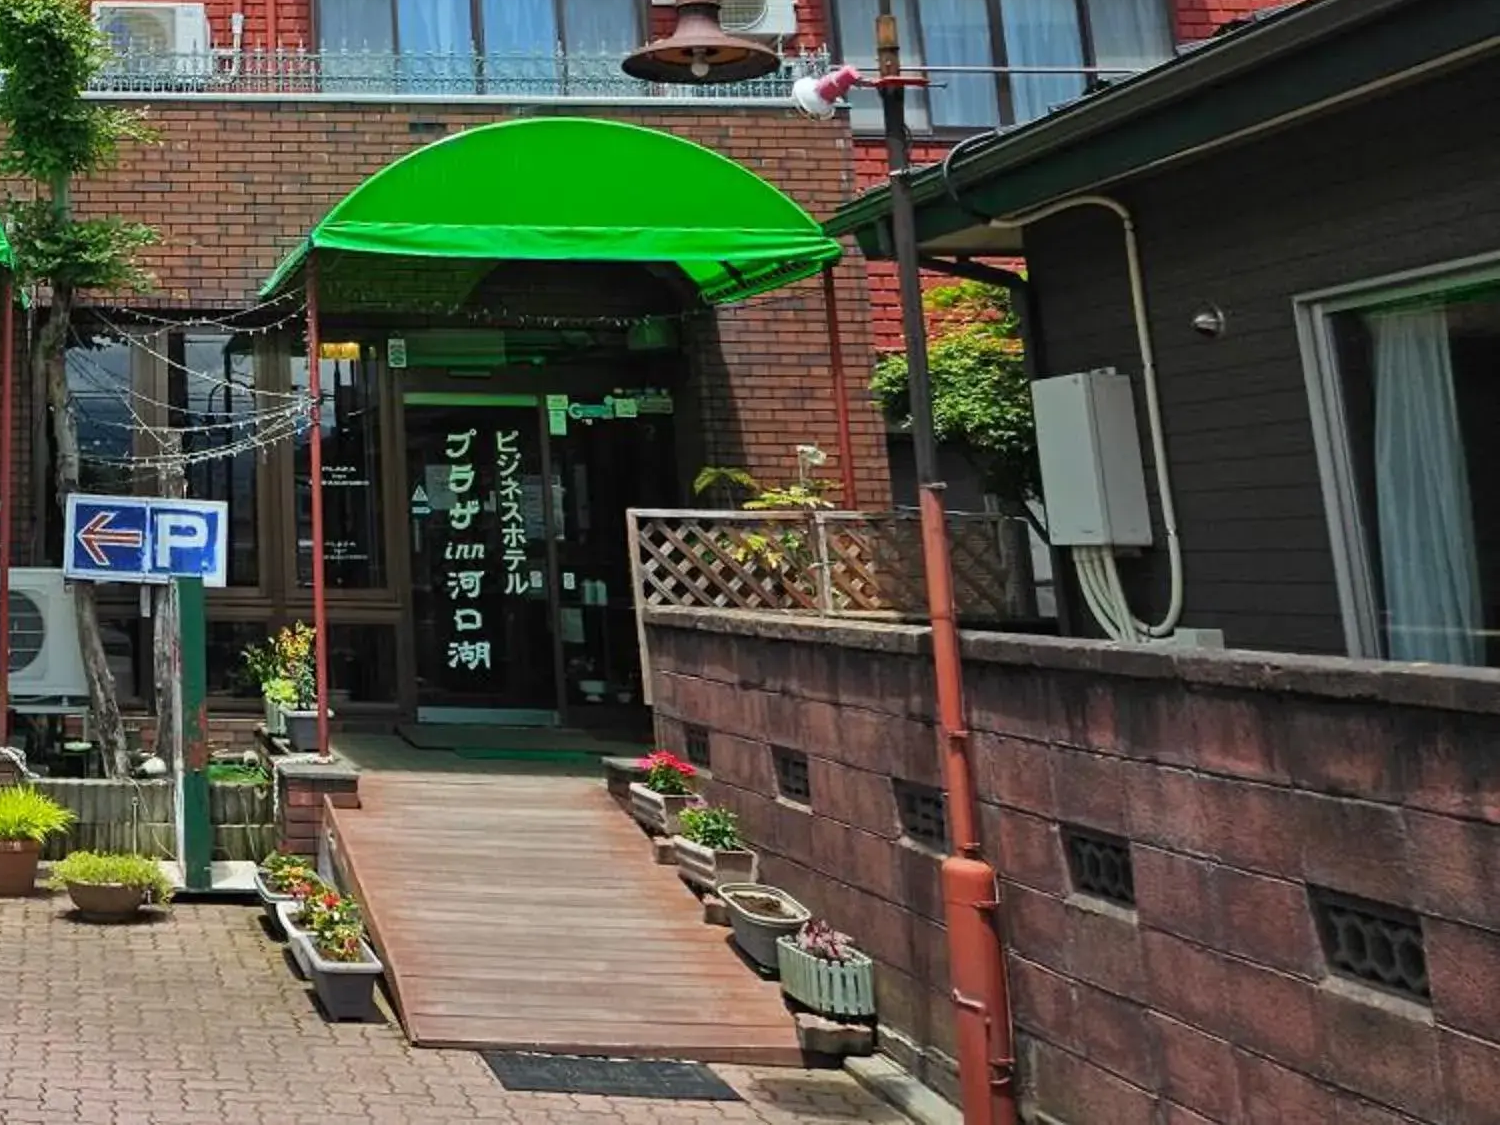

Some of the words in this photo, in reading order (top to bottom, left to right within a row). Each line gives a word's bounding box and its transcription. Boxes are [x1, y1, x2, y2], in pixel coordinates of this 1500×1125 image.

[155, 513, 209, 568] P
[496, 430, 529, 596] ビジネスホテル
